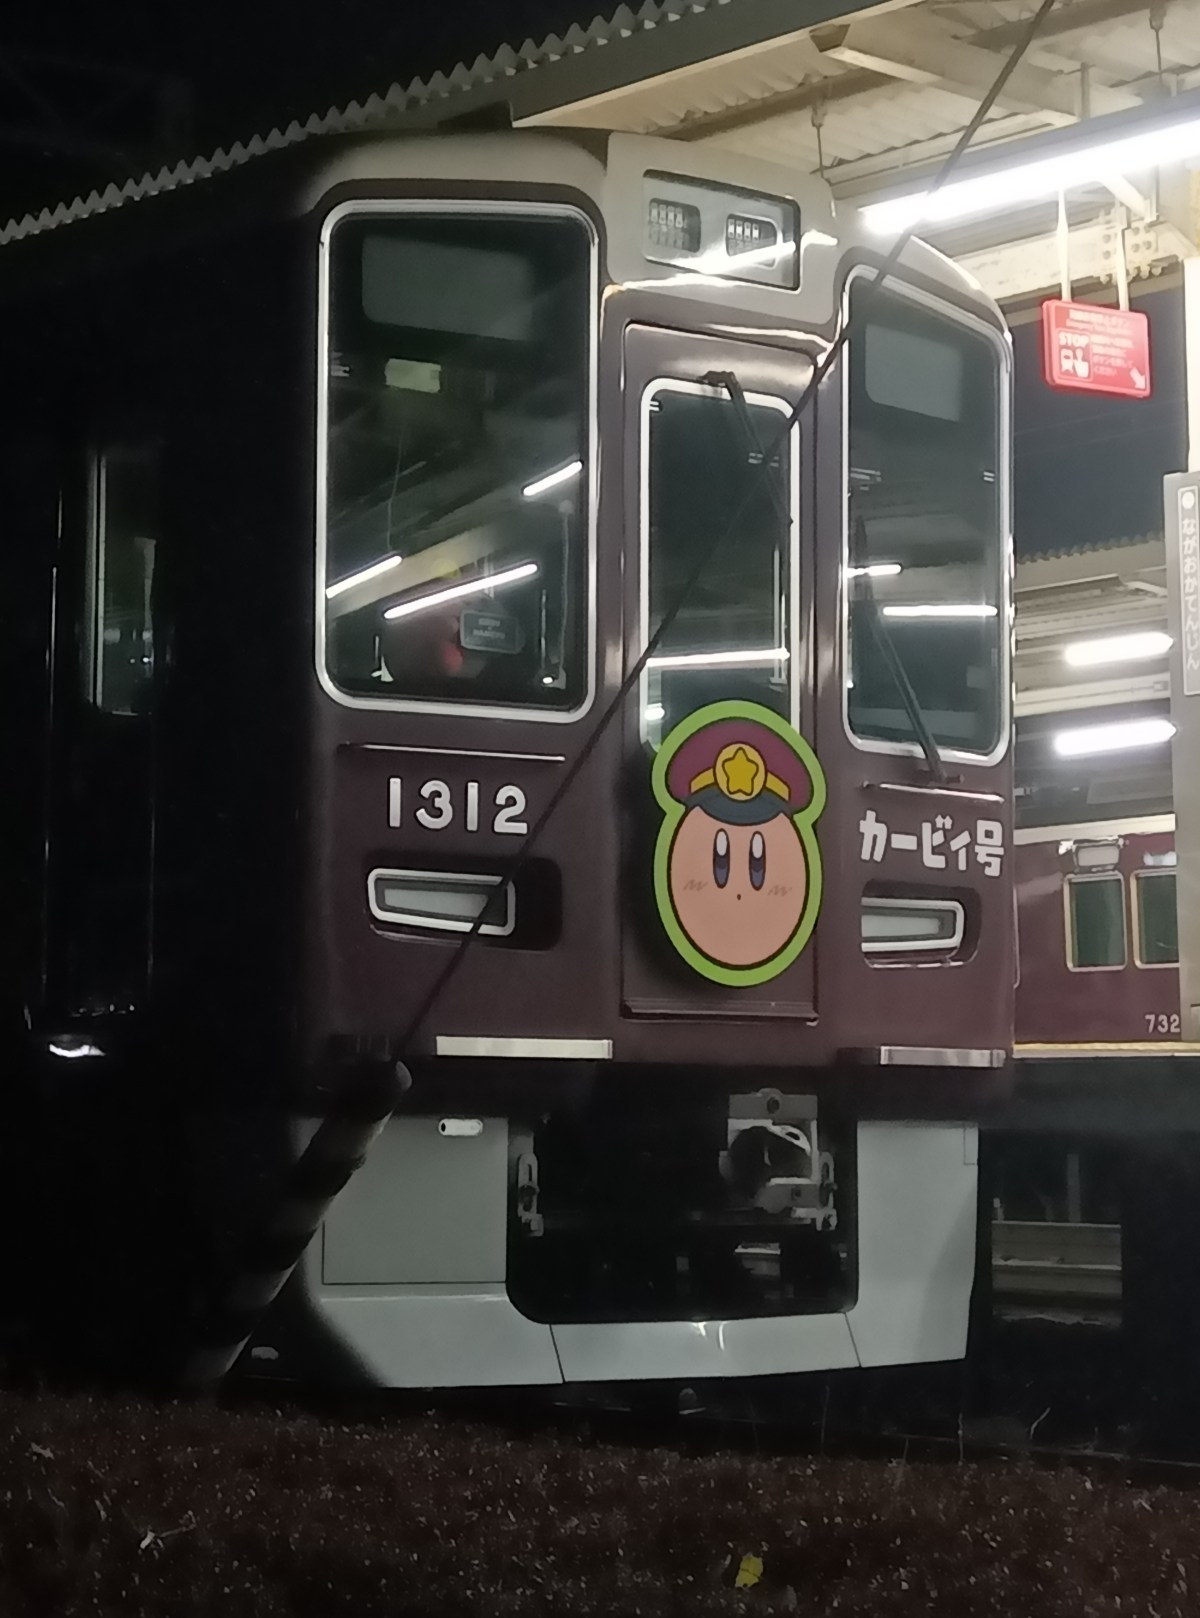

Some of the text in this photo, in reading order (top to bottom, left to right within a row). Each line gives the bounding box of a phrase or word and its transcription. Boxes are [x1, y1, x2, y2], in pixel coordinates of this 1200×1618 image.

[1058, 331, 1090, 347] STOP
[1181, 517, 1200, 671] ながおかてんじん
[389, 777, 528, 835] 1312
[859, 809, 1005, 877] カービィ号
[1144, 1013, 1180, 1033] 732
